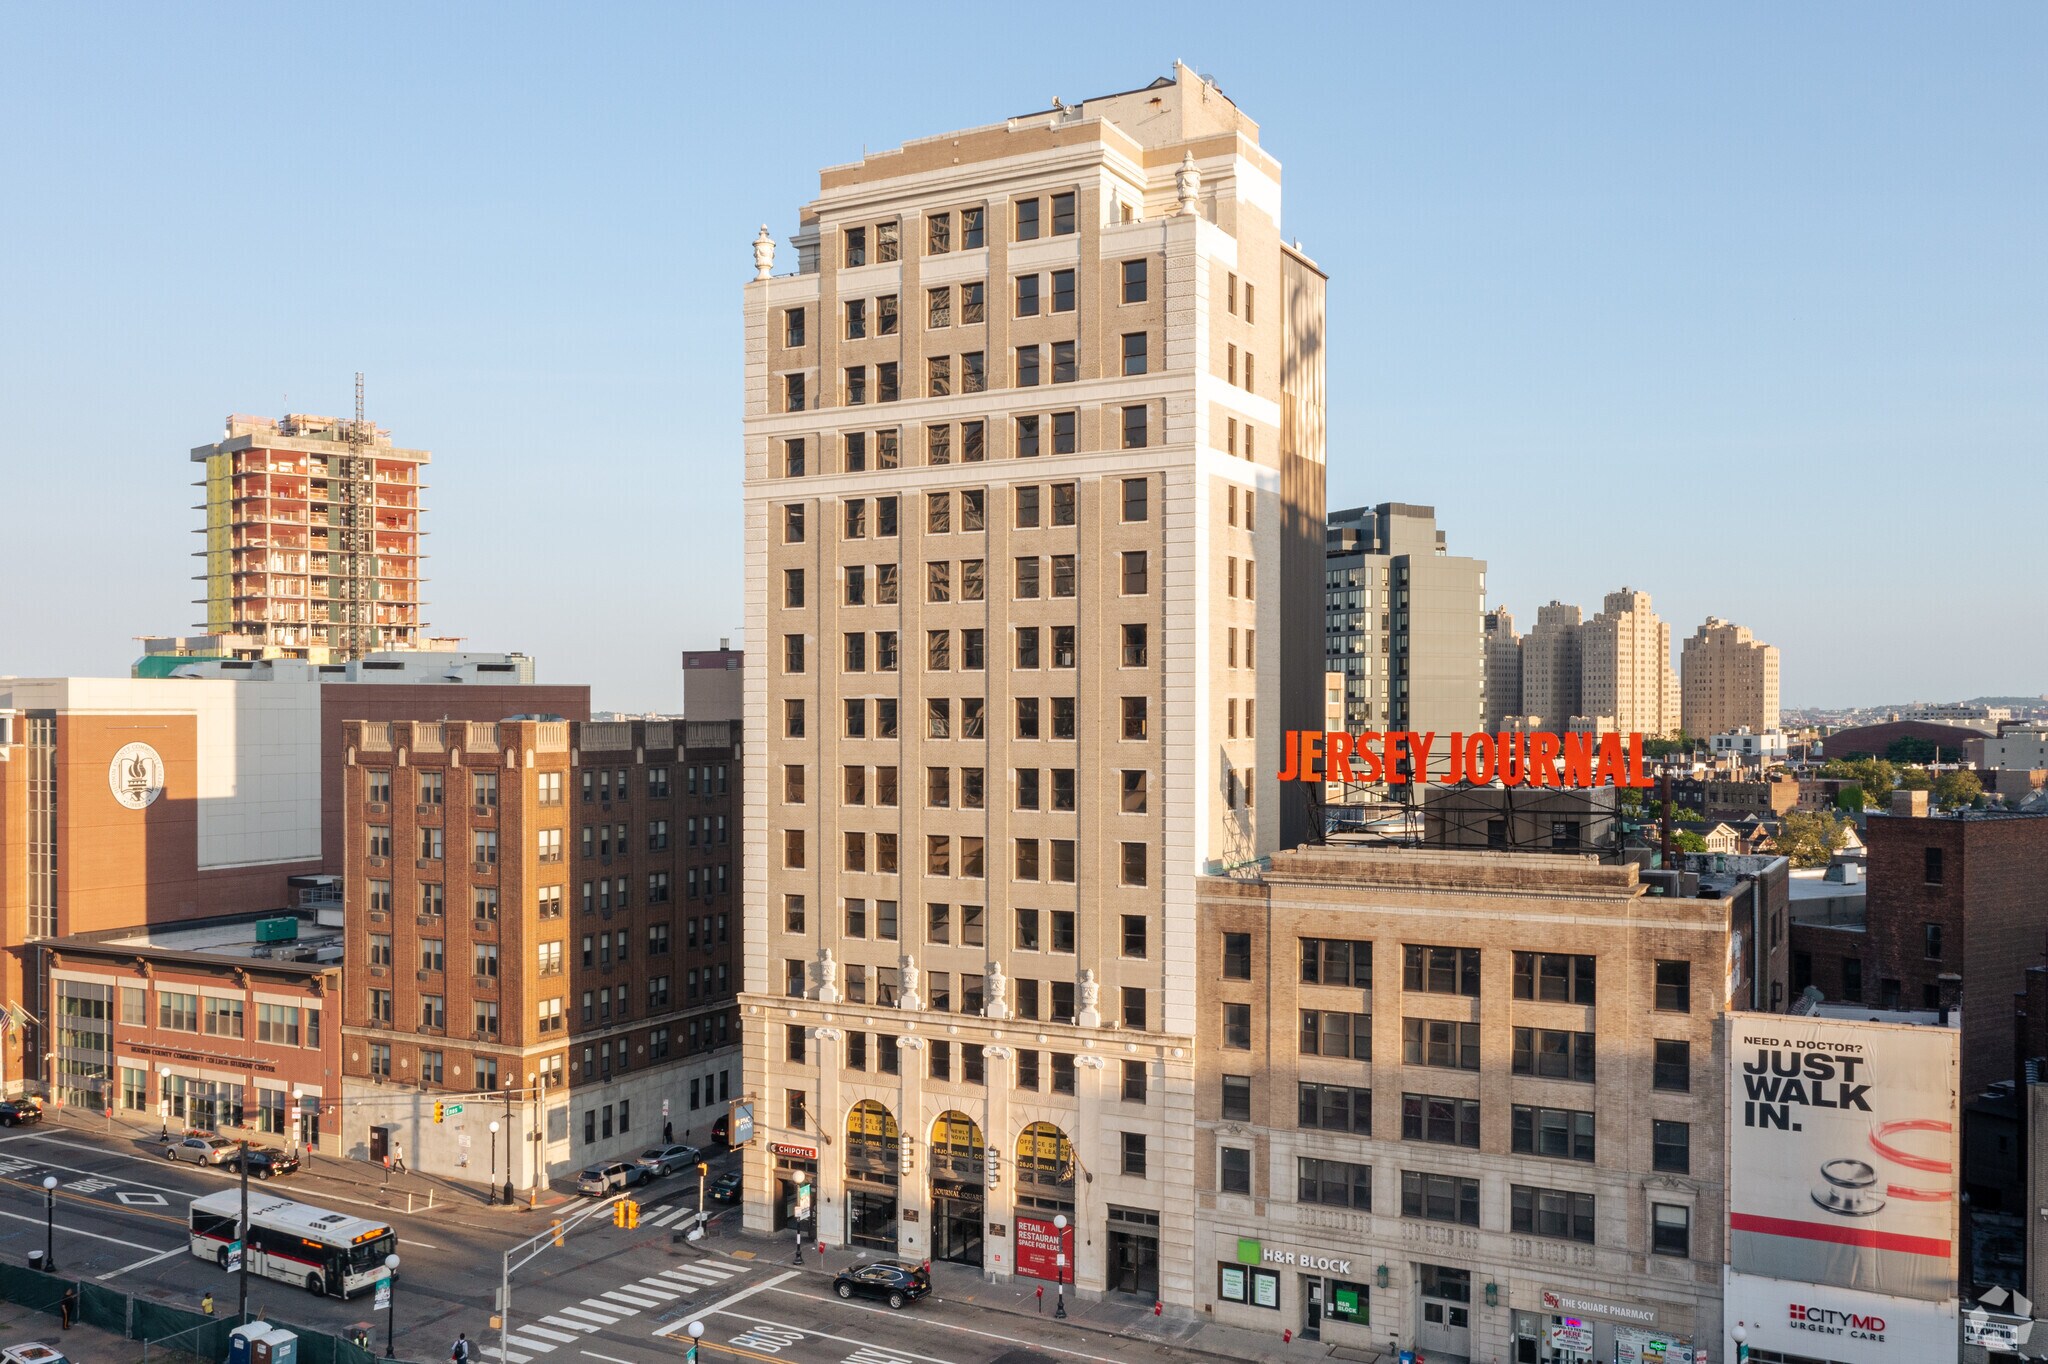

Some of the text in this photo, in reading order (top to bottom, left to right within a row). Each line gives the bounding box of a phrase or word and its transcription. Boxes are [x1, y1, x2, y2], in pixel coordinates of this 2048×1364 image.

[1277, 730, 1654, 788] JERSEY JOURNAL
[1744, 1036, 1863, 1053] NEED A DOCTOR?
[131, 1046, 276, 1072] HUDSON COUNTY COMMUNITY COLLEGE STUDENT CENTER
[1743, 1049, 1864, 1083] JUST
[1743, 1074, 1873, 1112] WALK
[1745, 1101, 1802, 1132] IN.
[854, 1122, 892, 1134] FOR LEASE
[951, 1128, 969, 1136] NEWLY
[778, 1146, 813, 1157] CHIPOTLE
[1045, 1148, 1068, 1157] LEASE
[1048, 1142, 1069, 1152] SPAC
[62, 1178, 118, 1194] BUS
[934, 1188, 982, 1200] JOURNAL SQUARE
[1018, 1222, 1046, 1234] RETAIL/
[1018, 1230, 1060, 1244] RESTAURAN
[1018, 1239, 1061, 1252] SPACE FOR LEAS
[1263, 1248, 1352, 1275] H&R BLOCK
[1337, 1306, 1357, 1314] BLOCK
[1338, 1300, 1350, 1308] H&R
[1562, 1298, 1654, 1321] THE SQUARE PHARMACY
[1806, 1307, 1886, 1332] CITYMD
[1562, 1330, 1582, 1338] HERE
[1790, 1321, 1885, 1342] URGENT CARE
[1966, 1326, 2016, 1340] TAEKWONDO
[728, 1326, 804, 1354] BUS
